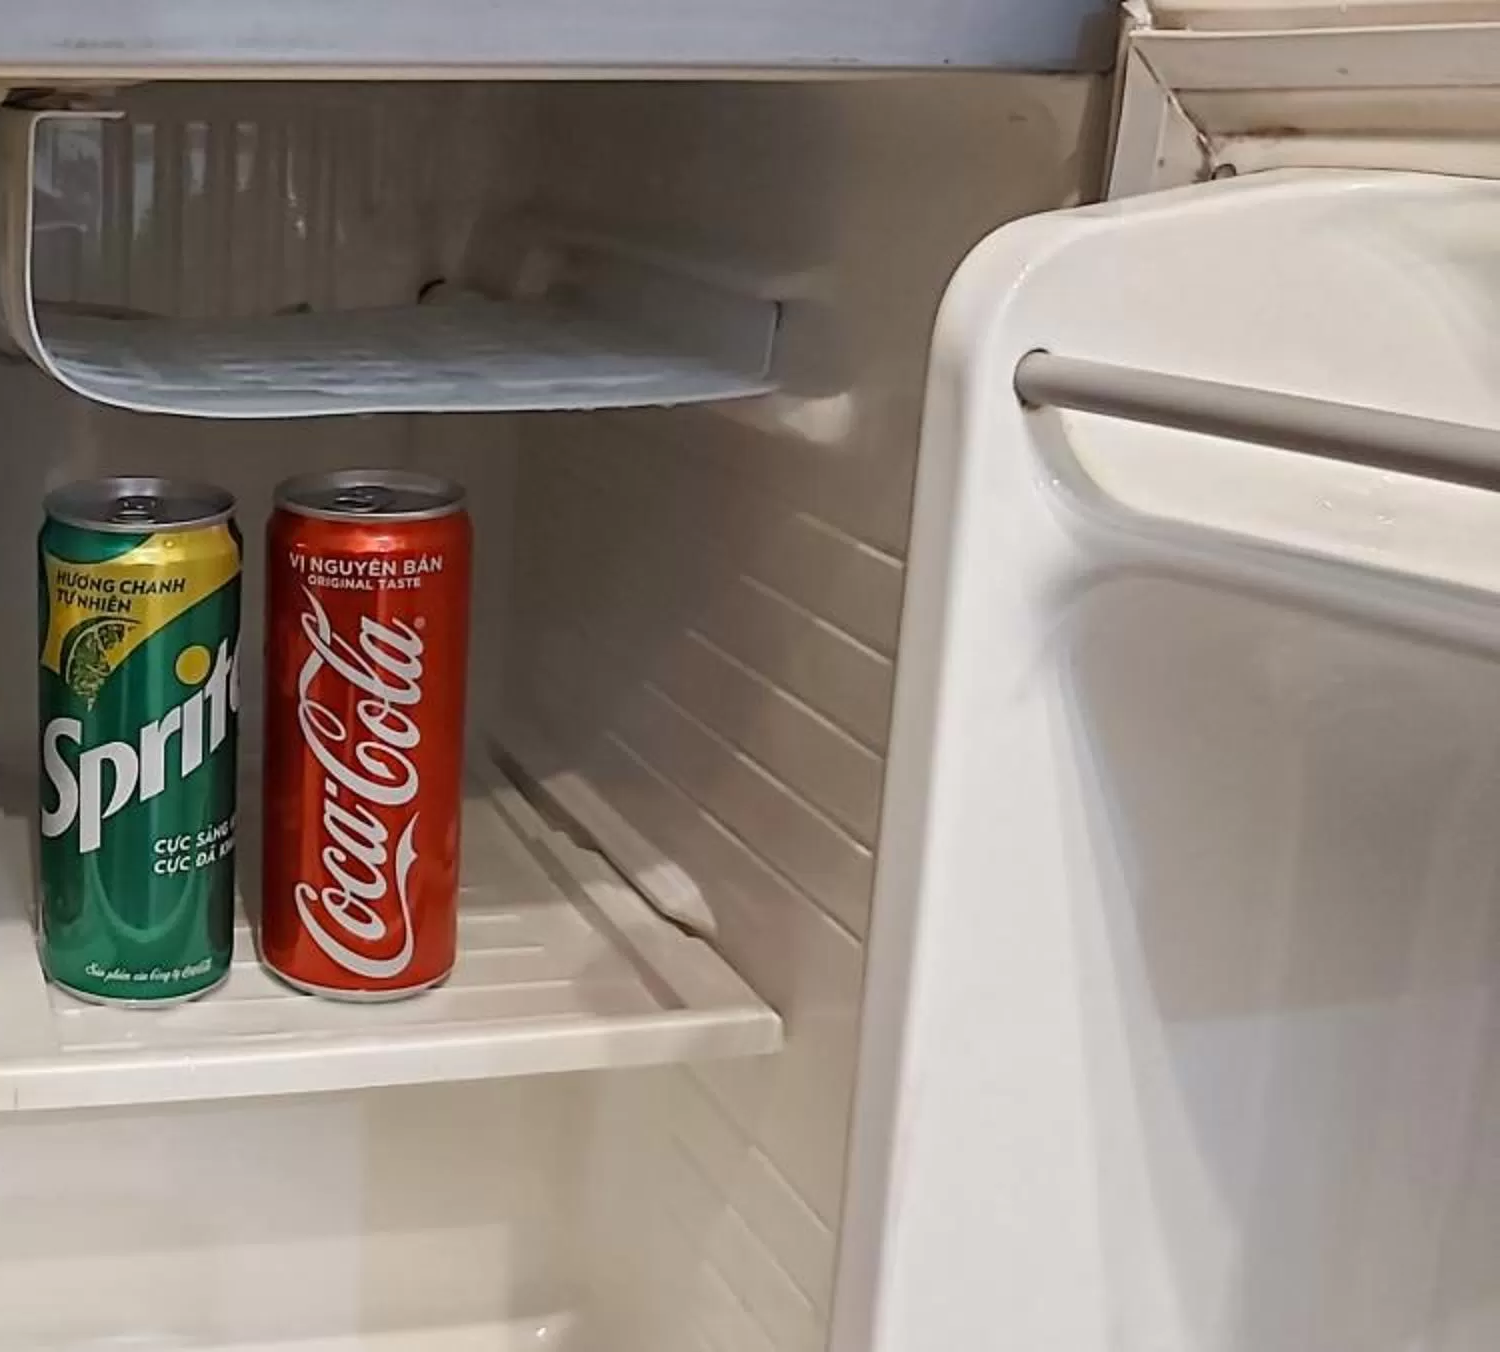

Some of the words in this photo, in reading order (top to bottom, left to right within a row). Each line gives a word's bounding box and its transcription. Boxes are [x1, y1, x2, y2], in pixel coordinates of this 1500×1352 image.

[309, 556, 397, 577] NGUYÊN
[119, 578, 186, 594] CHANH
[307, 574, 373, 590] ORIGINAL
[377, 577, 421, 590] TASTE
[77, 594, 133, 612] NHIÊN
